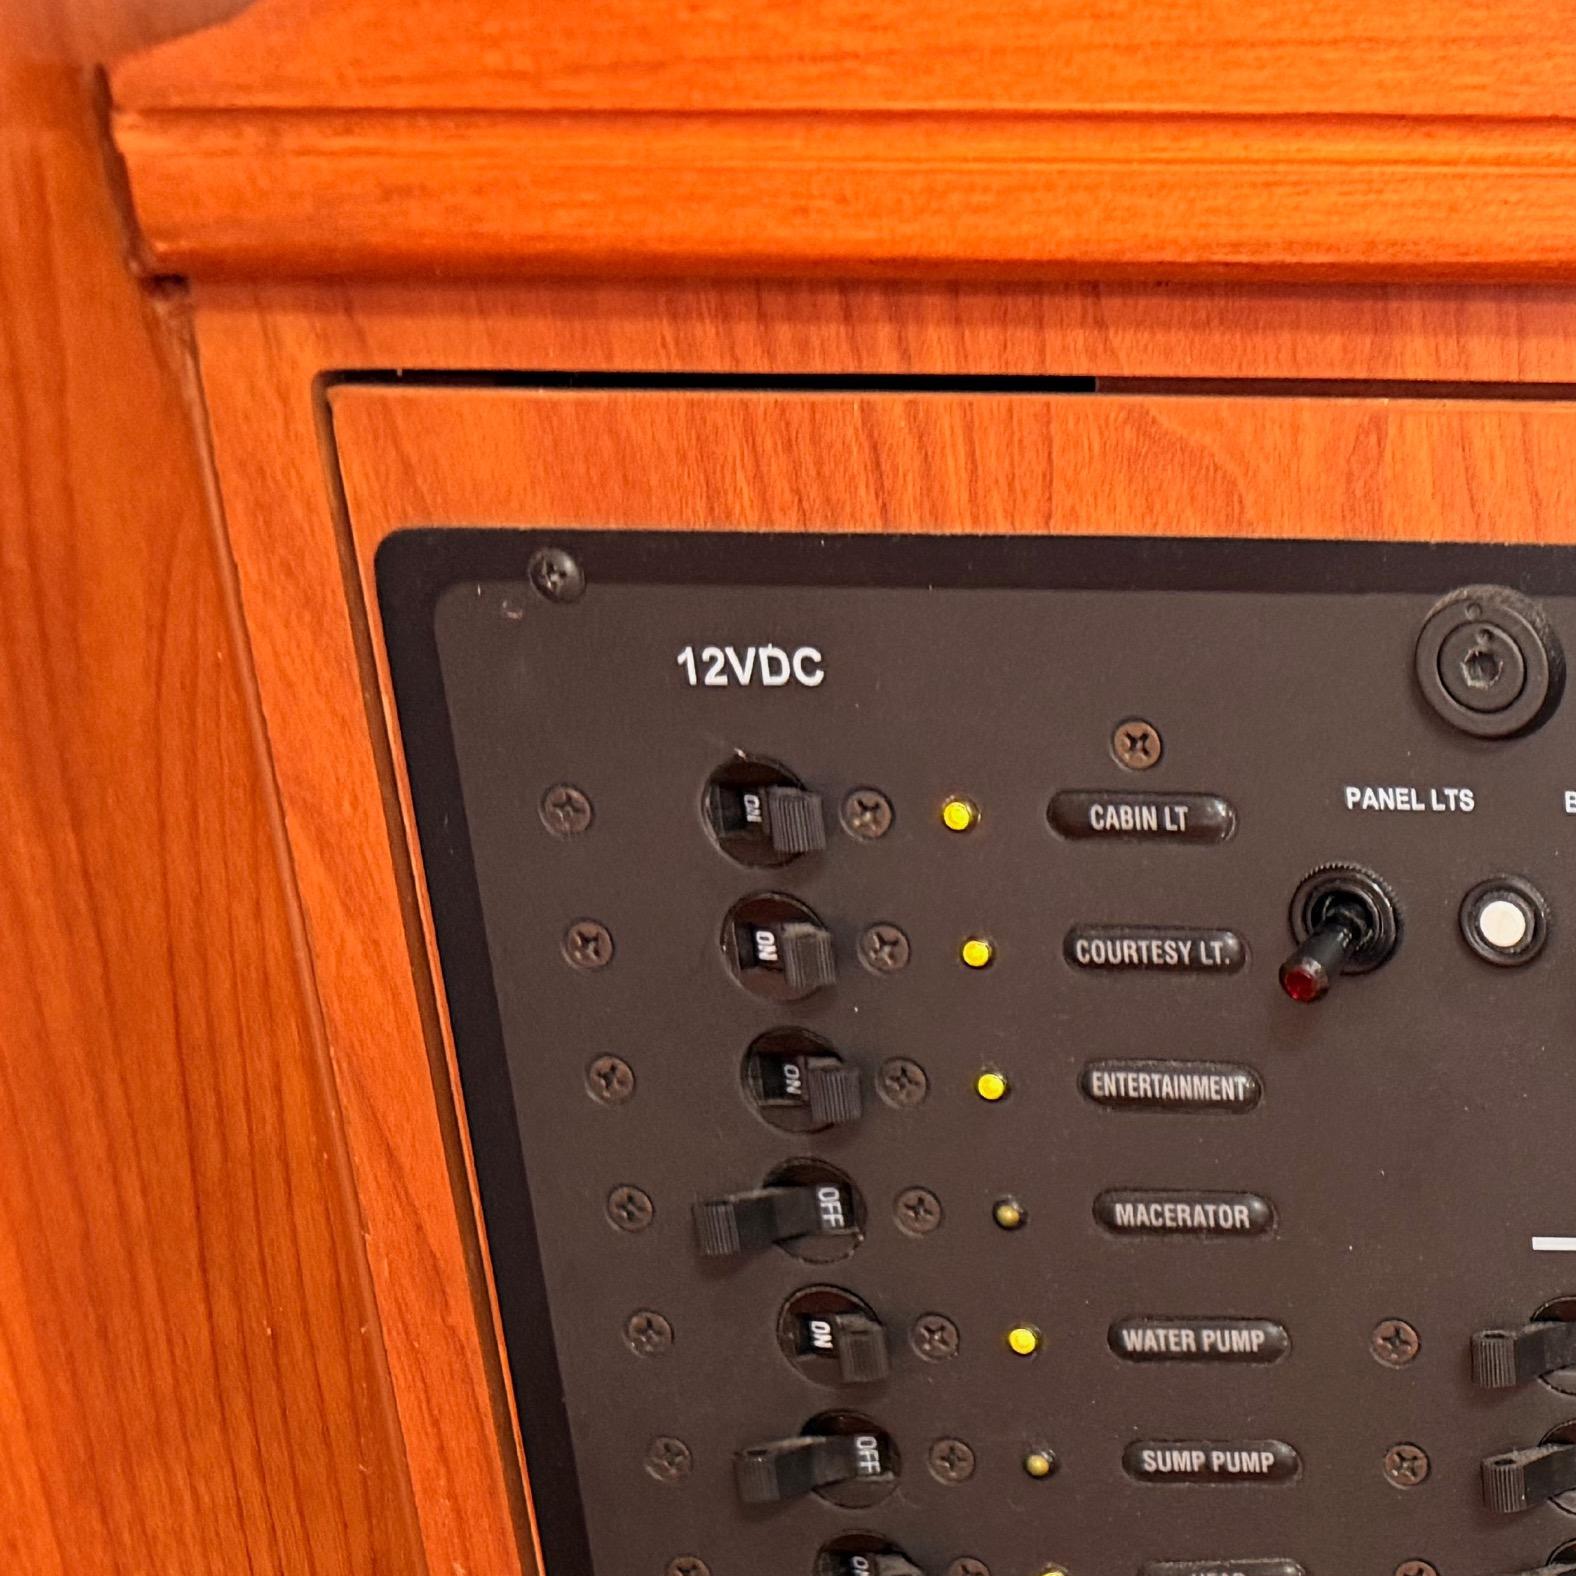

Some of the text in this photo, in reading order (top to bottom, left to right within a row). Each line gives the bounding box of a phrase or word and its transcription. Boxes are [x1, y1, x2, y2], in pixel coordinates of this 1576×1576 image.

[677, 644, 825, 687] 12VDC
[742, 793, 761, 824] ON
[1345, 786, 1475, 813] PANEL LTS
[1090, 804, 1188, 832] CABIN LT
[756, 930, 775, 962] ON
[1076, 938, 1231, 965] COURTESY LT.
[784, 1063, 800, 1096] ON
[1092, 1072, 1247, 1102] ENTERTAINMENT
[818, 1187, 844, 1228] OFF
[1115, 1203, 1250, 1229] MACERATOR
[810, 1320, 832, 1350] ON
[1122, 1328, 1265, 1354] WATER PUMP
[856, 1435, 879, 1475] OFF
[1142, 1450, 1275, 1474] SUMP PUMP
